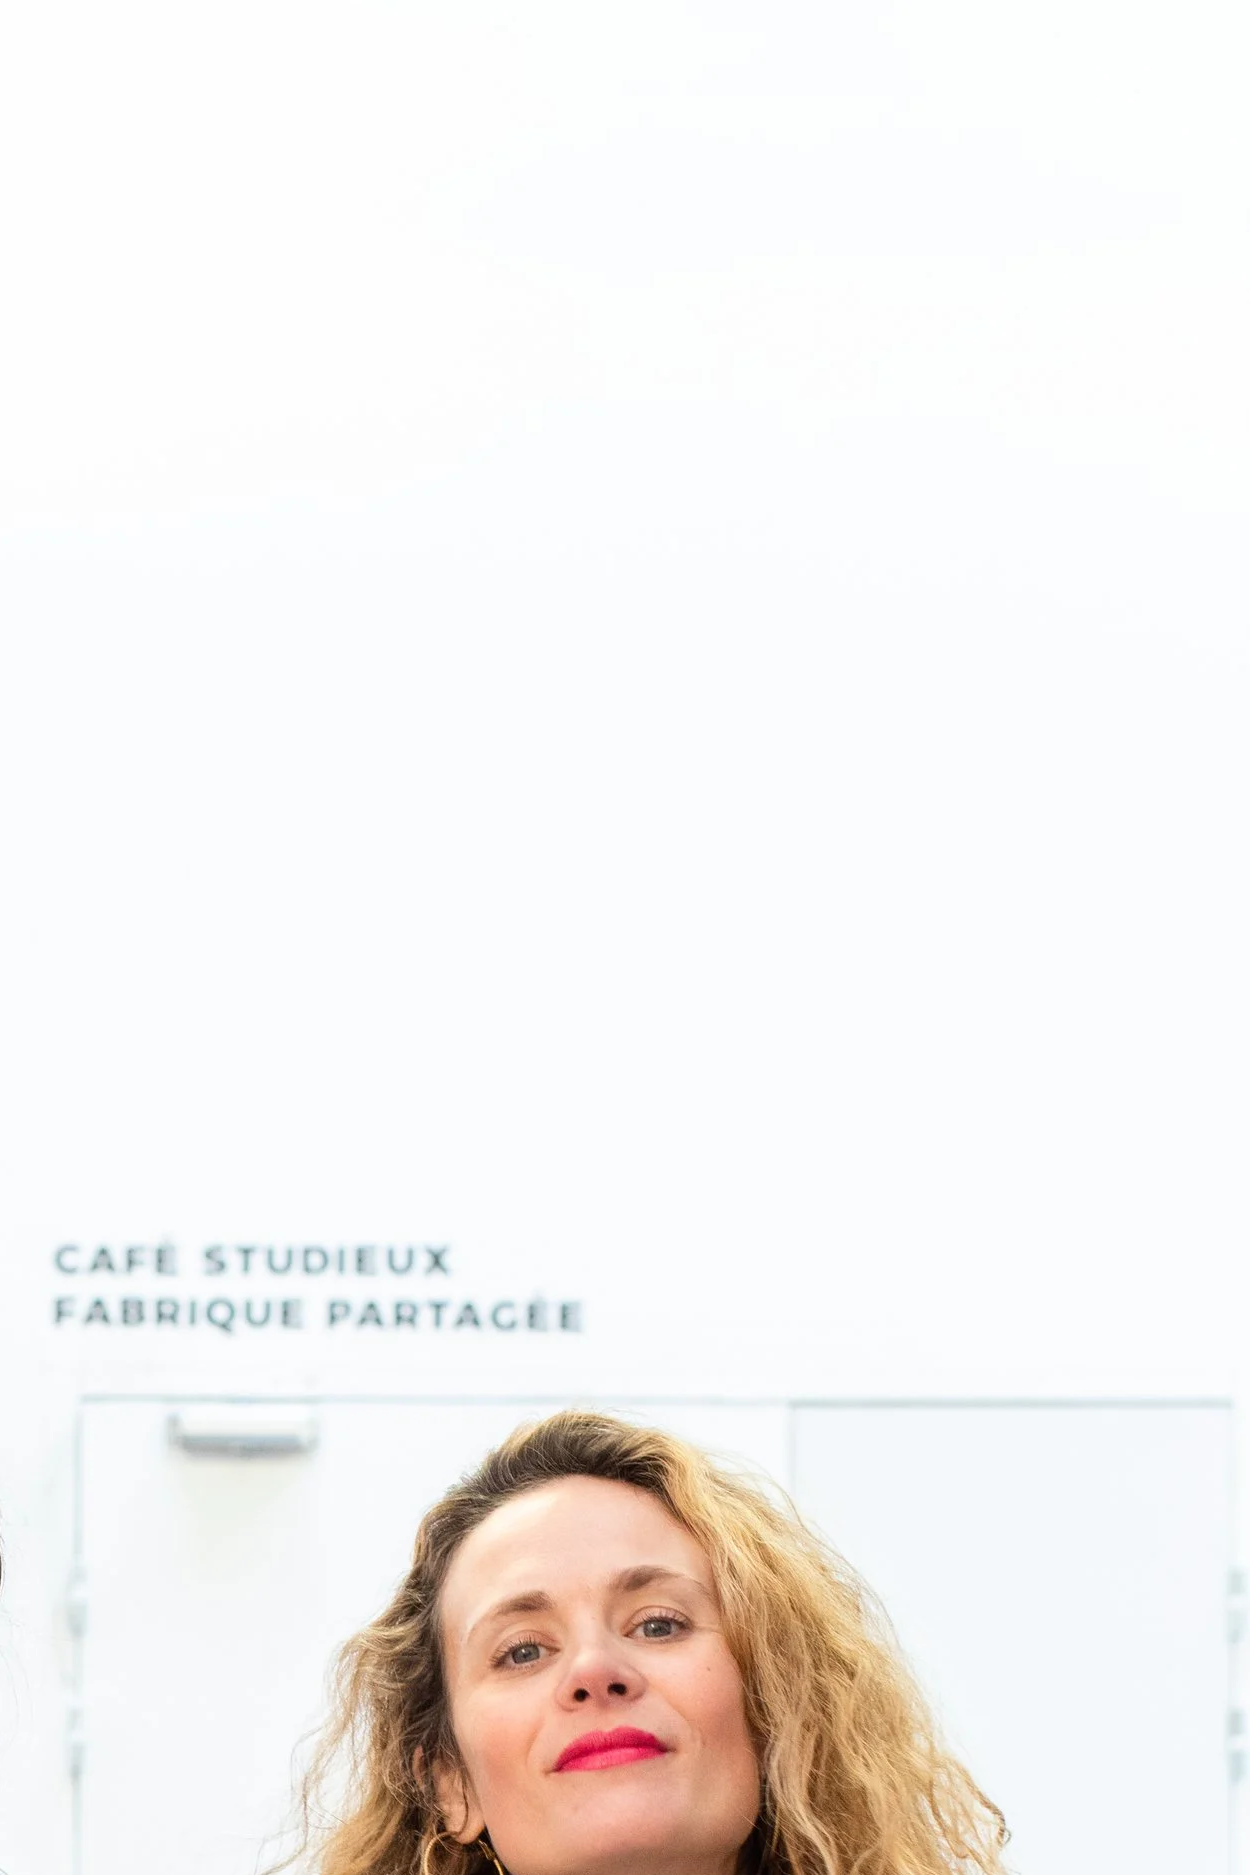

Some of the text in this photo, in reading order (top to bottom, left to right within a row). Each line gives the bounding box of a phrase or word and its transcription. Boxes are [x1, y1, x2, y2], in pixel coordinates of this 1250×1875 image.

[53, 1236, 451, 1277] CAFÉ STUDIEUX
[53, 1291, 582, 1336] FABRIQUE PARTAGÉE
